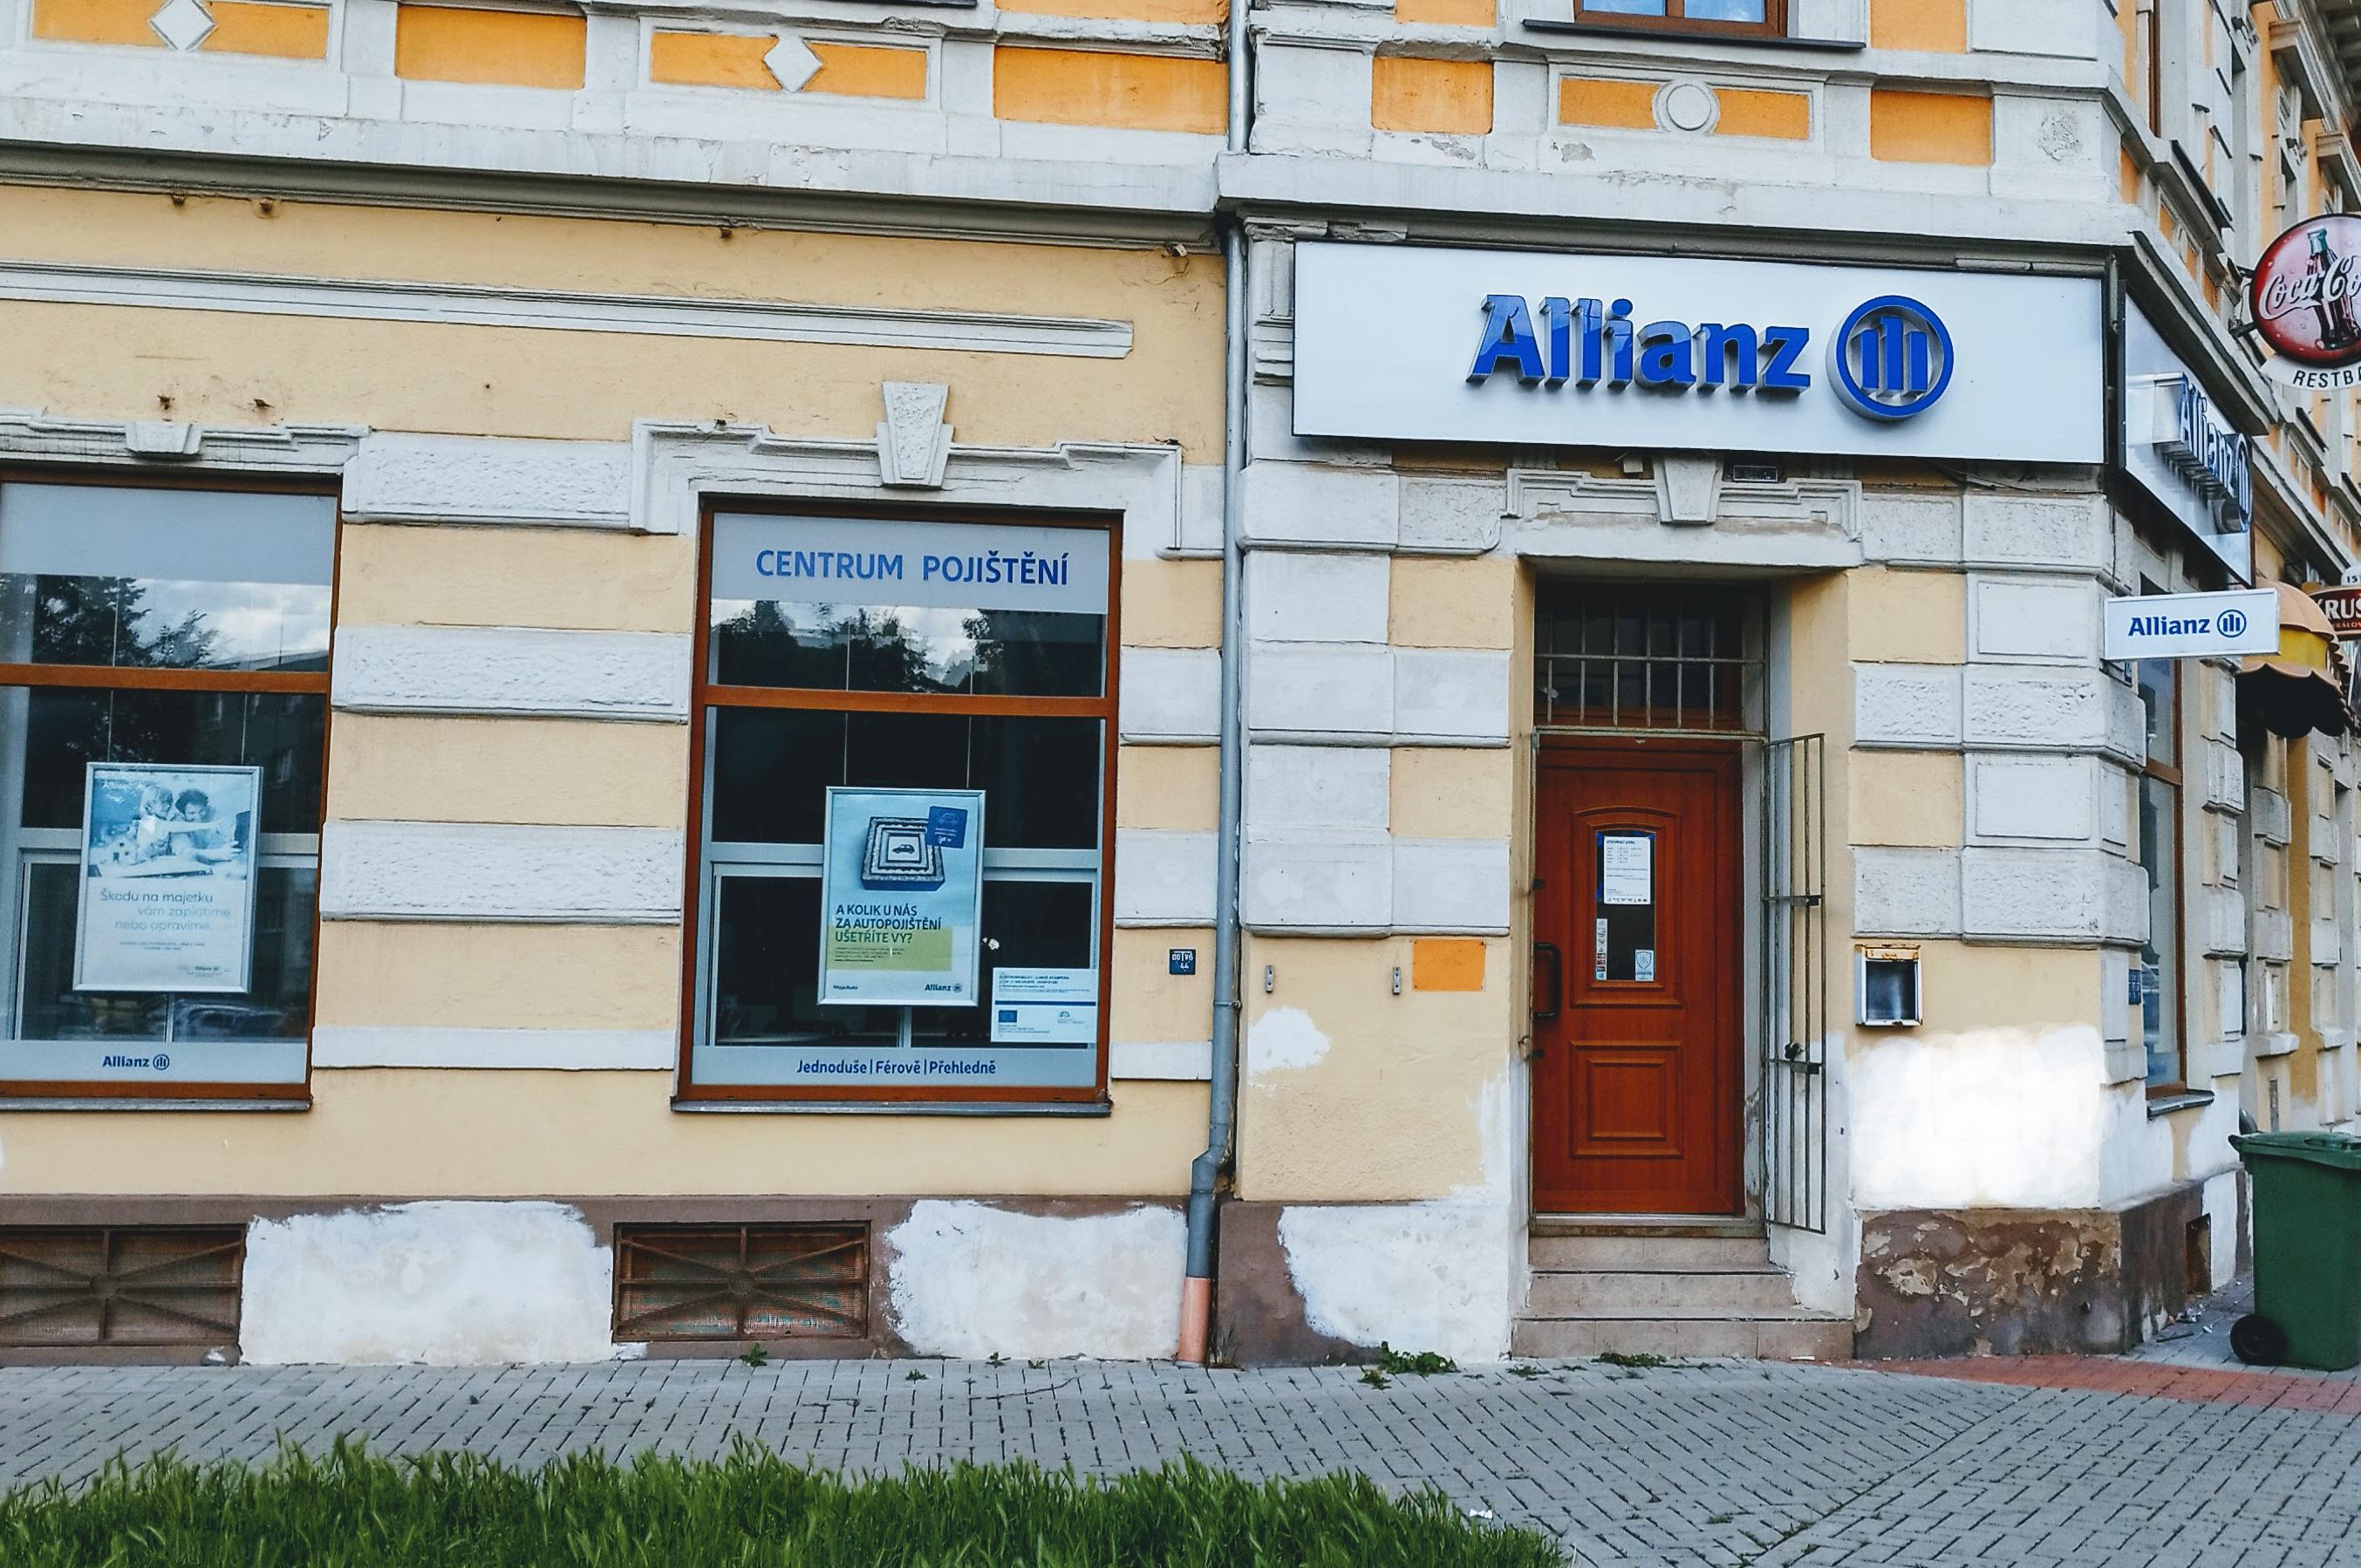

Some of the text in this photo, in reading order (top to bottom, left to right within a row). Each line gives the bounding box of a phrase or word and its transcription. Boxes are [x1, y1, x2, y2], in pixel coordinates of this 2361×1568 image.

[1467, 294, 1812, 396] Allianz
[756, 549, 1069, 585] CENTRUM POJIŠTĚNÍ
[2127, 616, 2211, 637] Allianz
[100, 888, 213, 904] Škodu na majetku
[836, 903, 918, 917] A KOLIK U NÁS
[836, 917, 941, 931] ZA AUTOPOJIŠTĚNÍ
[835, 929, 913, 944] UŠETŘÍTE VY?
[925, 983, 952, 992] Allianz
[102, 1055, 151, 1068] Allianz
[796, 1059, 997, 1074] Jednoduše Férově Přehledně
